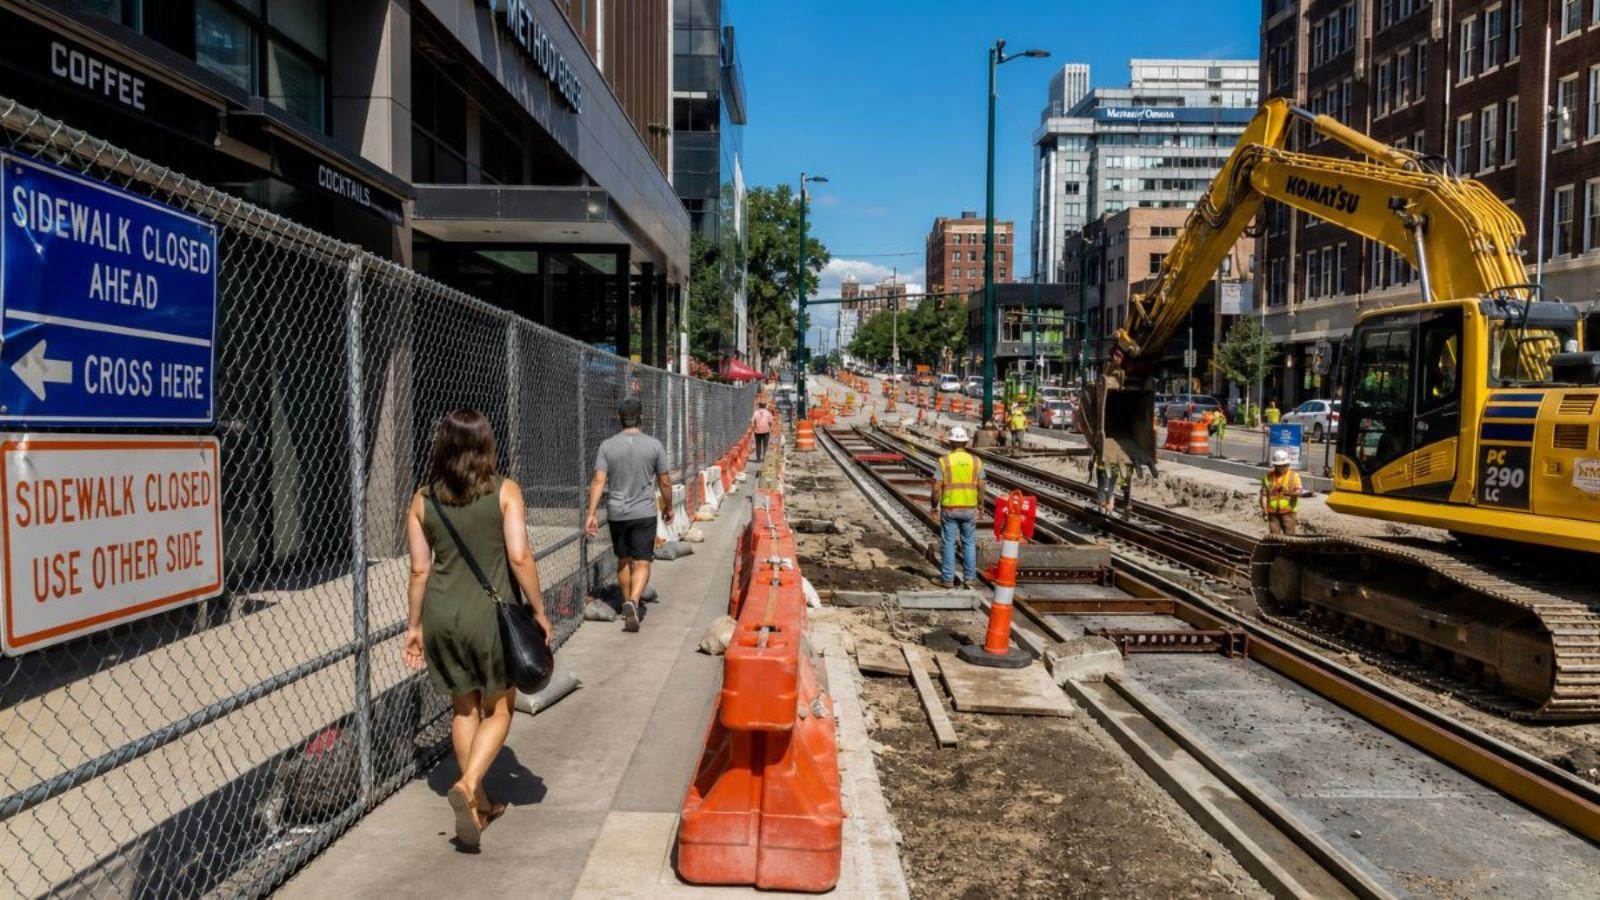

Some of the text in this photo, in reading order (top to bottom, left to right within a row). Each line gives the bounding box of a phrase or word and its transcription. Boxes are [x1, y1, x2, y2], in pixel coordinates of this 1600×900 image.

[507, 0, 556, 82] METHOD
[51, 41, 146, 111] COFFEE
[318, 164, 371, 206] COCKTAILS
[1285, 175, 1360, 214] KOMATSU
[12, 185, 211, 275] SIDEWALK CLOSED
[89, 263, 159, 310] AHEAD
[84, 355, 205, 400] CROSS HERE
[1484, 466, 1525, 489] 290
[1486, 449, 1507, 465] PC
[15, 470, 211, 528] SIDEWALK CLOSED
[1484, 488, 1500, 502] LC
[33, 530, 204, 603] USE OTHER SIDE
